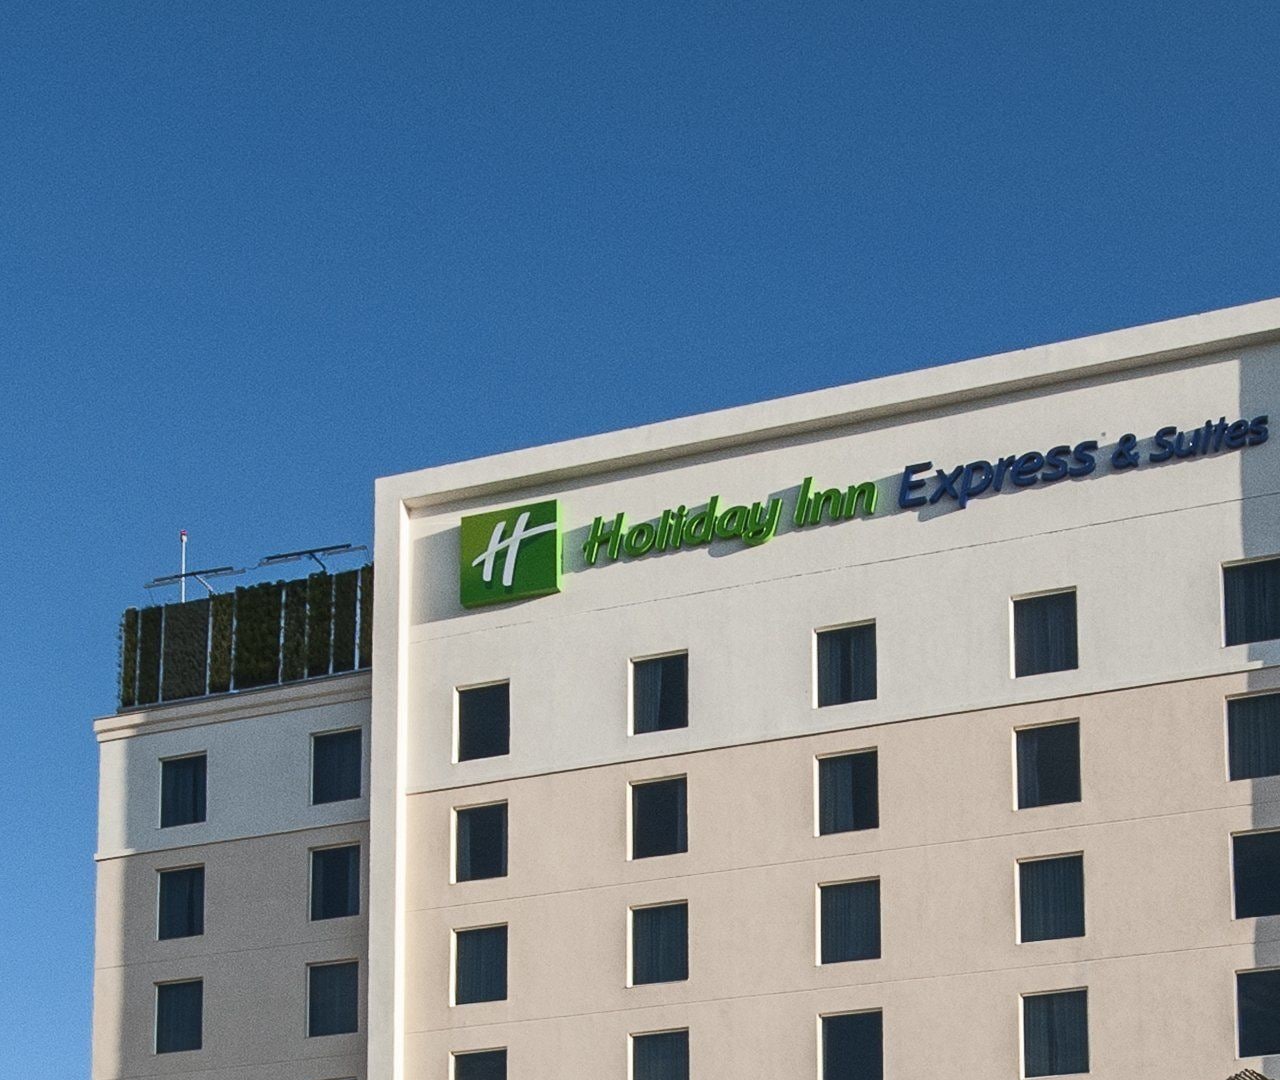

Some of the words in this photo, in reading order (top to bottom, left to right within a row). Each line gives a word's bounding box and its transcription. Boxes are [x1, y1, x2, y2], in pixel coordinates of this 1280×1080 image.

[582, 495, 781, 565] Holiday
[793, 476, 878, 526] Inn
[899, 440, 1098, 509] Express
[1110, 433, 1139, 469] &
[1149, 415, 1269, 462] Suites
